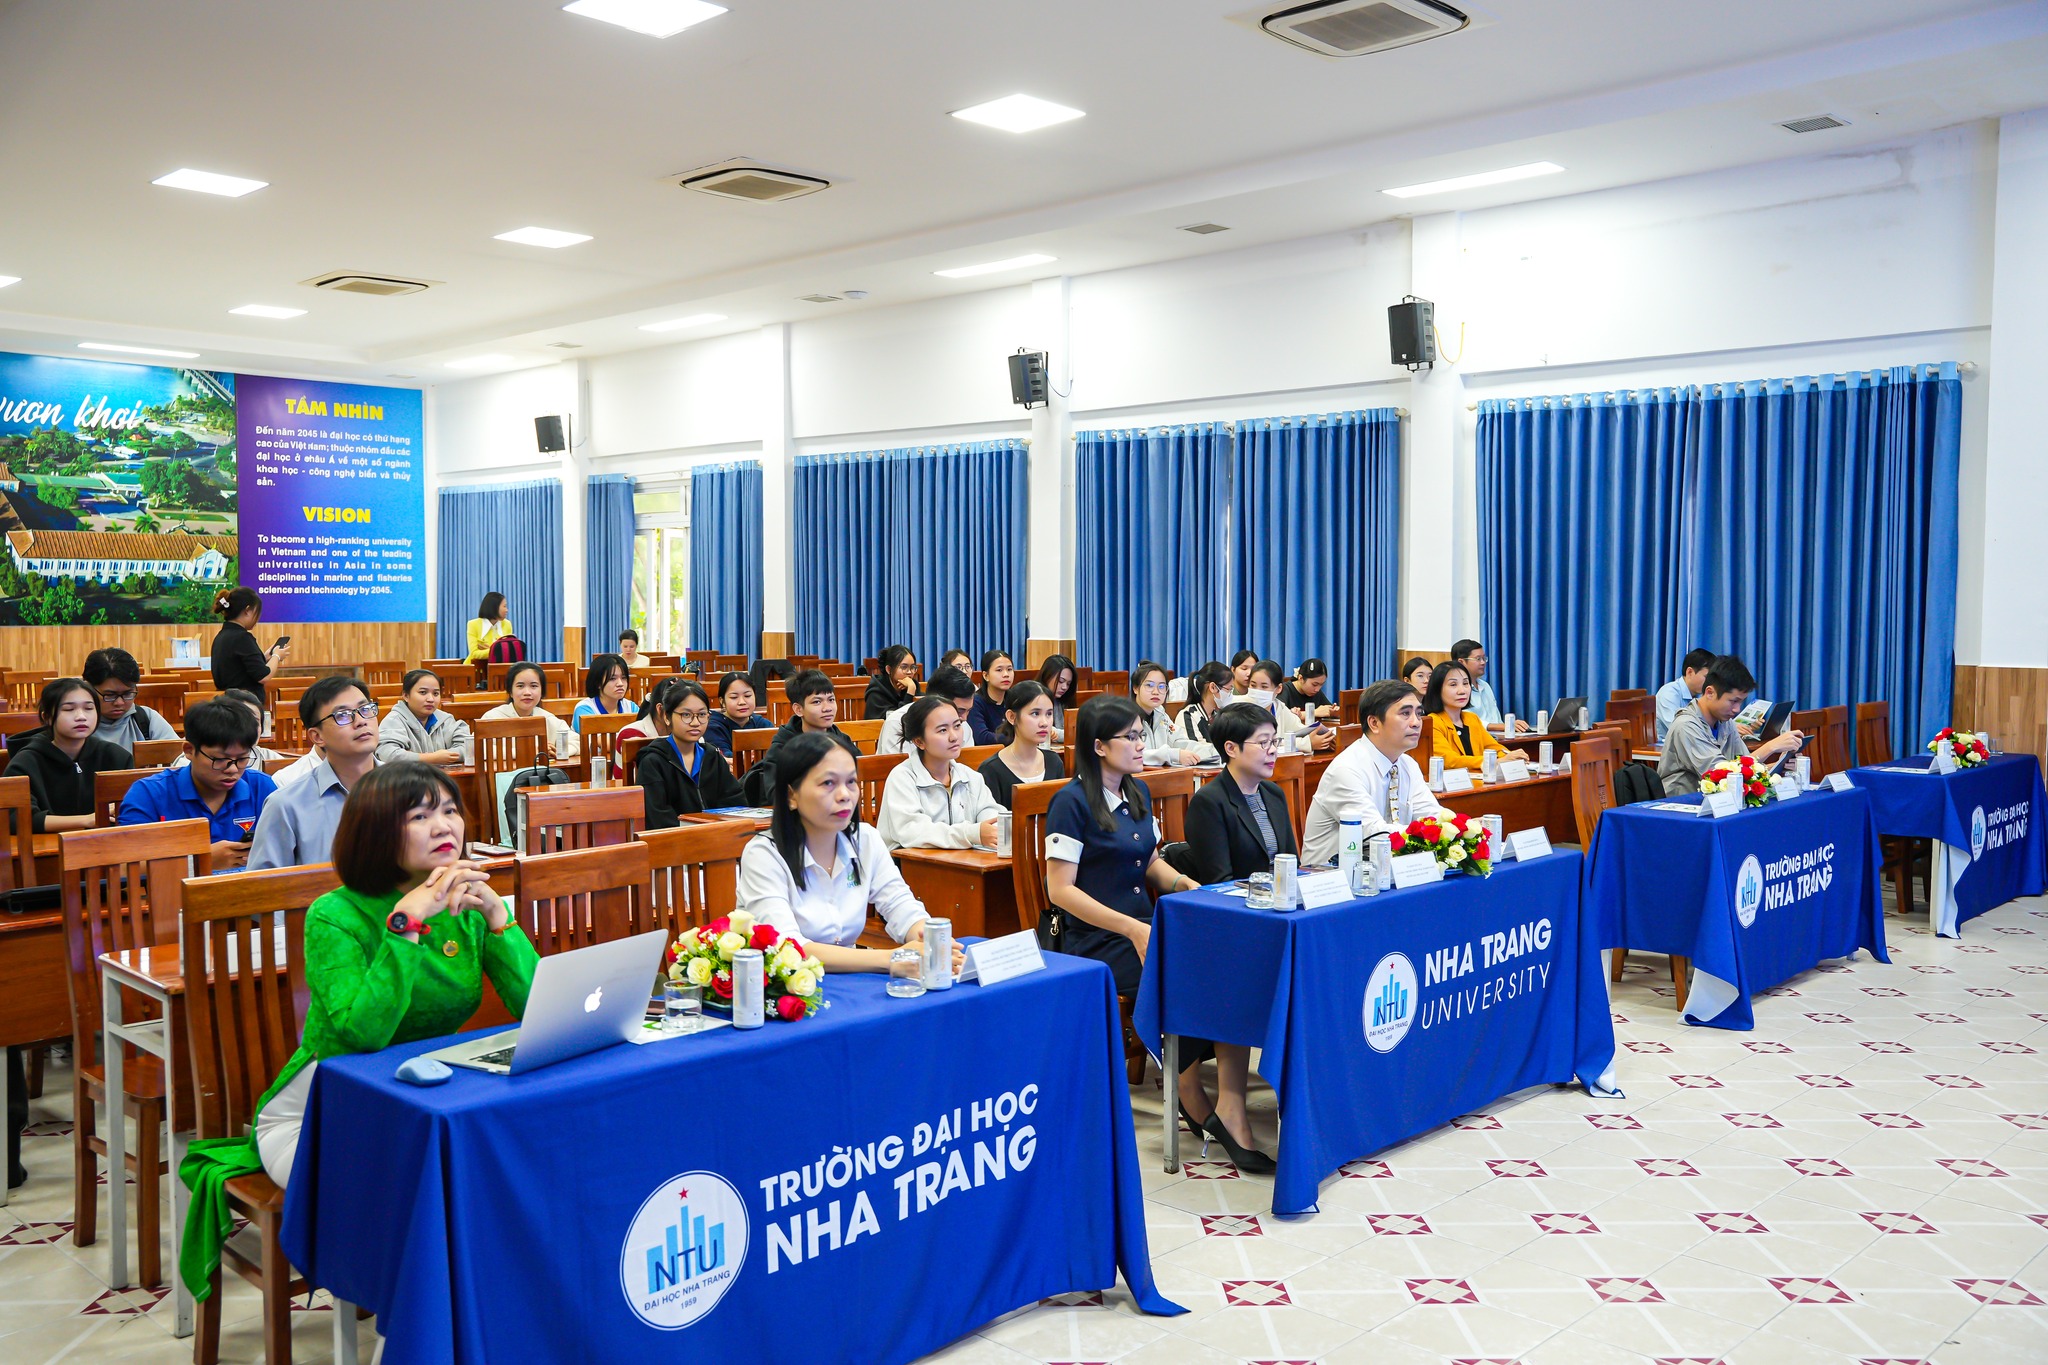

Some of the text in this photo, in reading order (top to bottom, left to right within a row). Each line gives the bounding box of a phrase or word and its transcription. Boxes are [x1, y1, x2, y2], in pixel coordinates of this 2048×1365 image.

[73, 394, 142, 429] khơi
[285, 396, 383, 420] TẦM NHÌN
[256, 426, 273, 435] Đến
[276, 428, 295, 436] năm
[297, 429, 317, 437] 2045
[330, 431, 342, 440] đại
[345, 432, 360, 442] học
[363, 433, 373, 441] có
[375, 434, 388, 442] thứ
[390, 435, 410, 445] hạng
[274, 439, 289, 448] của
[290, 441, 306, 450] Việt
[331, 444, 354, 453] thuộc
[356, 445, 379, 454] nhóm
[397, 447, 410, 456] các
[256, 452, 270, 462] đại
[274, 453, 291, 463] học
[352, 457, 368, 467] một
[385, 460, 410, 469] ngành
[257, 465, 278, 473] khoa
[282, 466, 298, 476] học
[309, 468, 330, 478] công
[334, 468, 355, 479] nghệ
[380, 470, 390, 479] và
[303, 507, 371, 522] VISION
[258, 534, 268, 543] To
[271, 535, 305, 543] become
[316, 536, 369, 546] high-ranking
[372, 537, 411, 547] university
[258, 560, 323, 569] universities
[345, 561, 366, 569] Asia
[271, 548, 306, 556] Vietnam
[352, 549, 360, 557] of
[365, 549, 378, 557] the
[382, 550, 412, 559] leading
[258, 573, 306, 582] disciplines
[259, 586, 392, 595] science and technology by 2045.
[1987, 828, 2003, 850] NHA
[1766, 855, 1801, 881] TRƯỜNG
[1803, 850, 1816, 872] ĐẠI
[1765, 864, 1832, 911] NHA TRANG
[1425, 918, 1551, 987] NHA TRANG
[1422, 962, 1550, 1029] UNIVERSITY
[1376, 999, 1404, 1026] NTU
[760, 1083, 1038, 1212] TRƯỜNG ĐẠI HỌC
[766, 1124, 1037, 1274] NHA TRANG
[655, 1239, 718, 1292] NTU
[662, 1291, 680, 1304] HỌC
[682, 1282, 700, 1296] NHA
[702, 1270, 730, 1288] TRANG
[681, 1297, 697, 1310] 1959
